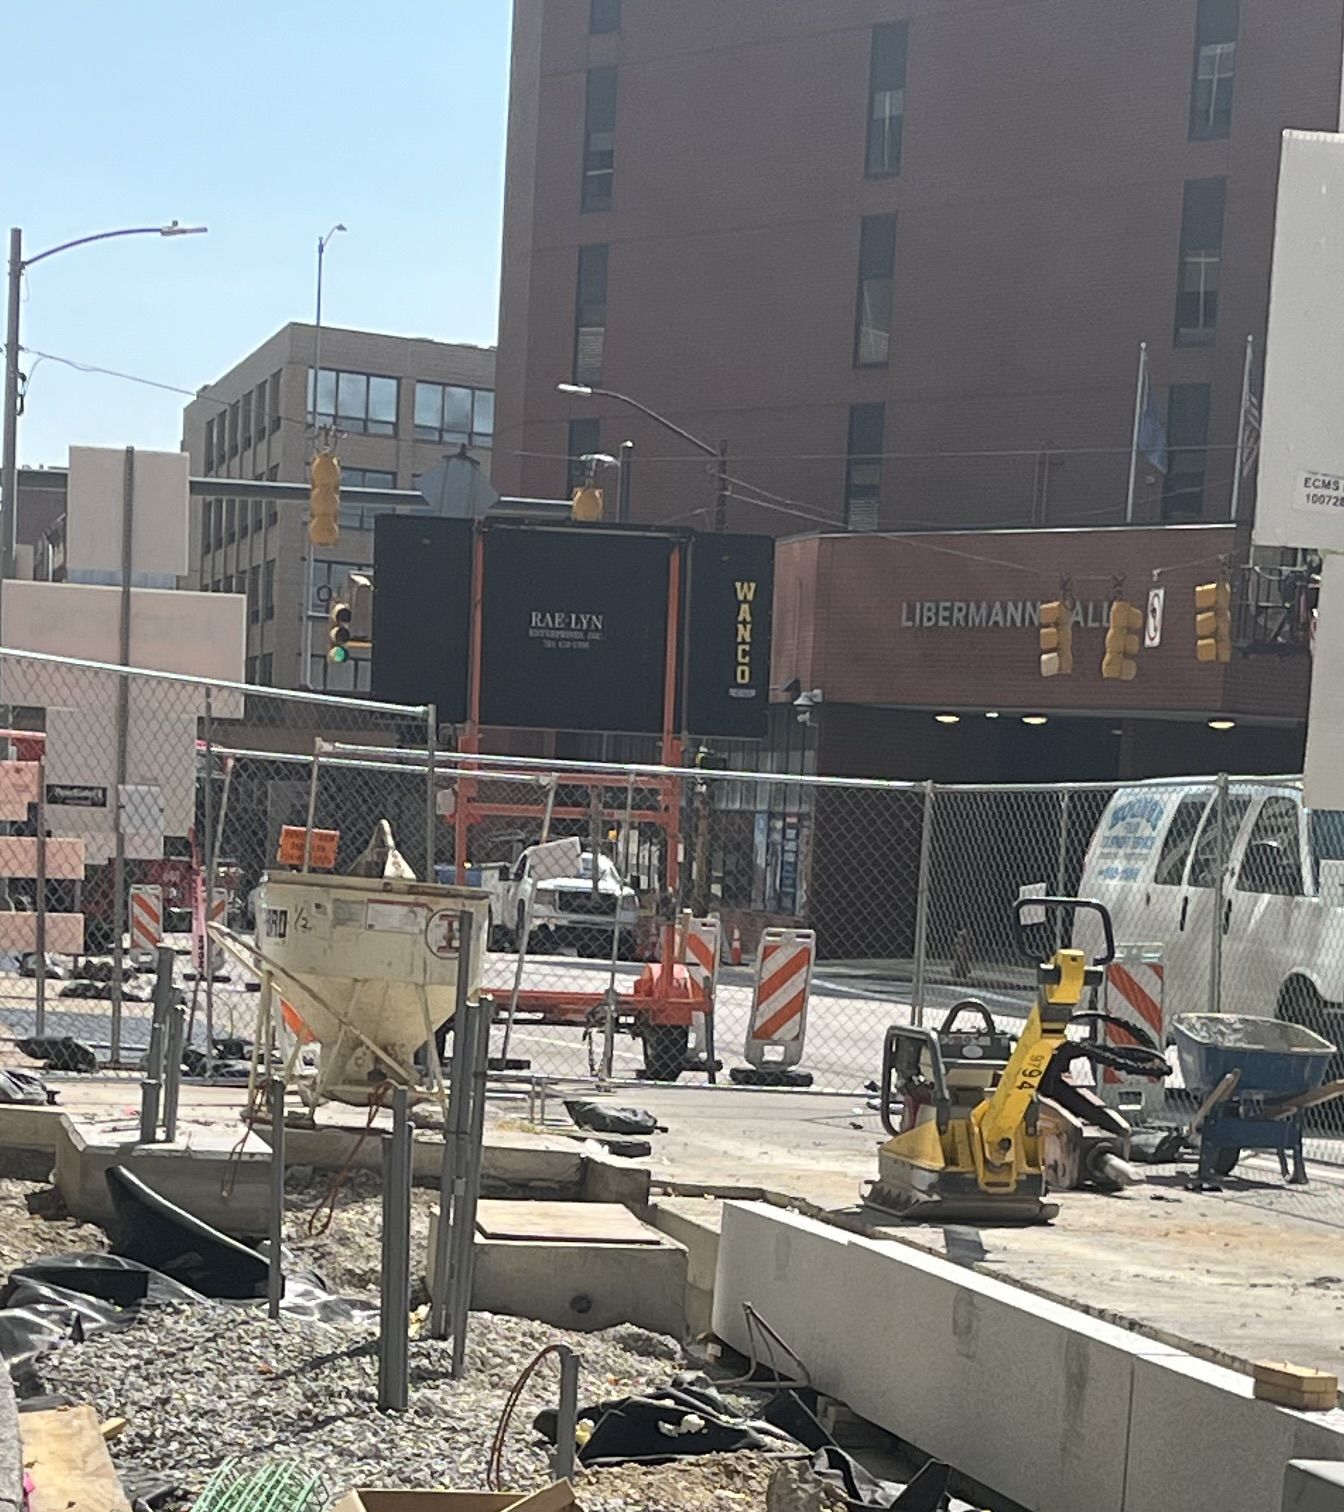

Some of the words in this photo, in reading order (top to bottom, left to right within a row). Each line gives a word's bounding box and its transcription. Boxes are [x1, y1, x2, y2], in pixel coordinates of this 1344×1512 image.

[1304, 477, 1340, 491] ECMS
[901, 601, 1040, 627] LIBERMANN
[735, 581, 756, 684] WANCO
